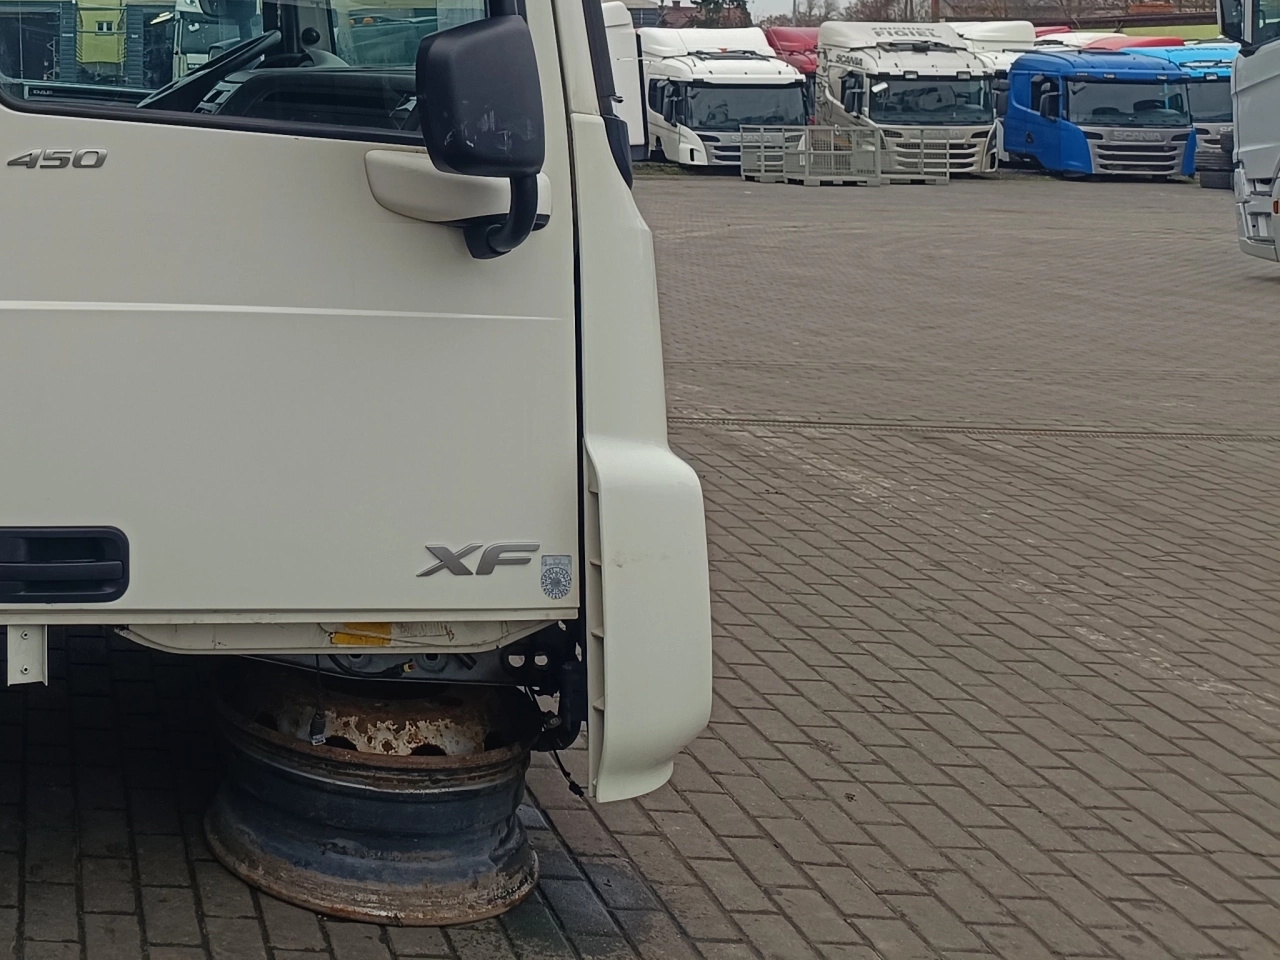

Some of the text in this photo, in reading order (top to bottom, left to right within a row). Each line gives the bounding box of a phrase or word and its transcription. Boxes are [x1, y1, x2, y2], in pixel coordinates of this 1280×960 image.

[874, 30, 942, 38] FIGIEL
[835, 53, 863, 66] SCANIA
[731, 135, 773, 143] SCANA
[1114, 131, 1162, 141] SCANIA
[7, 148, 108, 169] 450
[416, 542, 540, 577] XF
